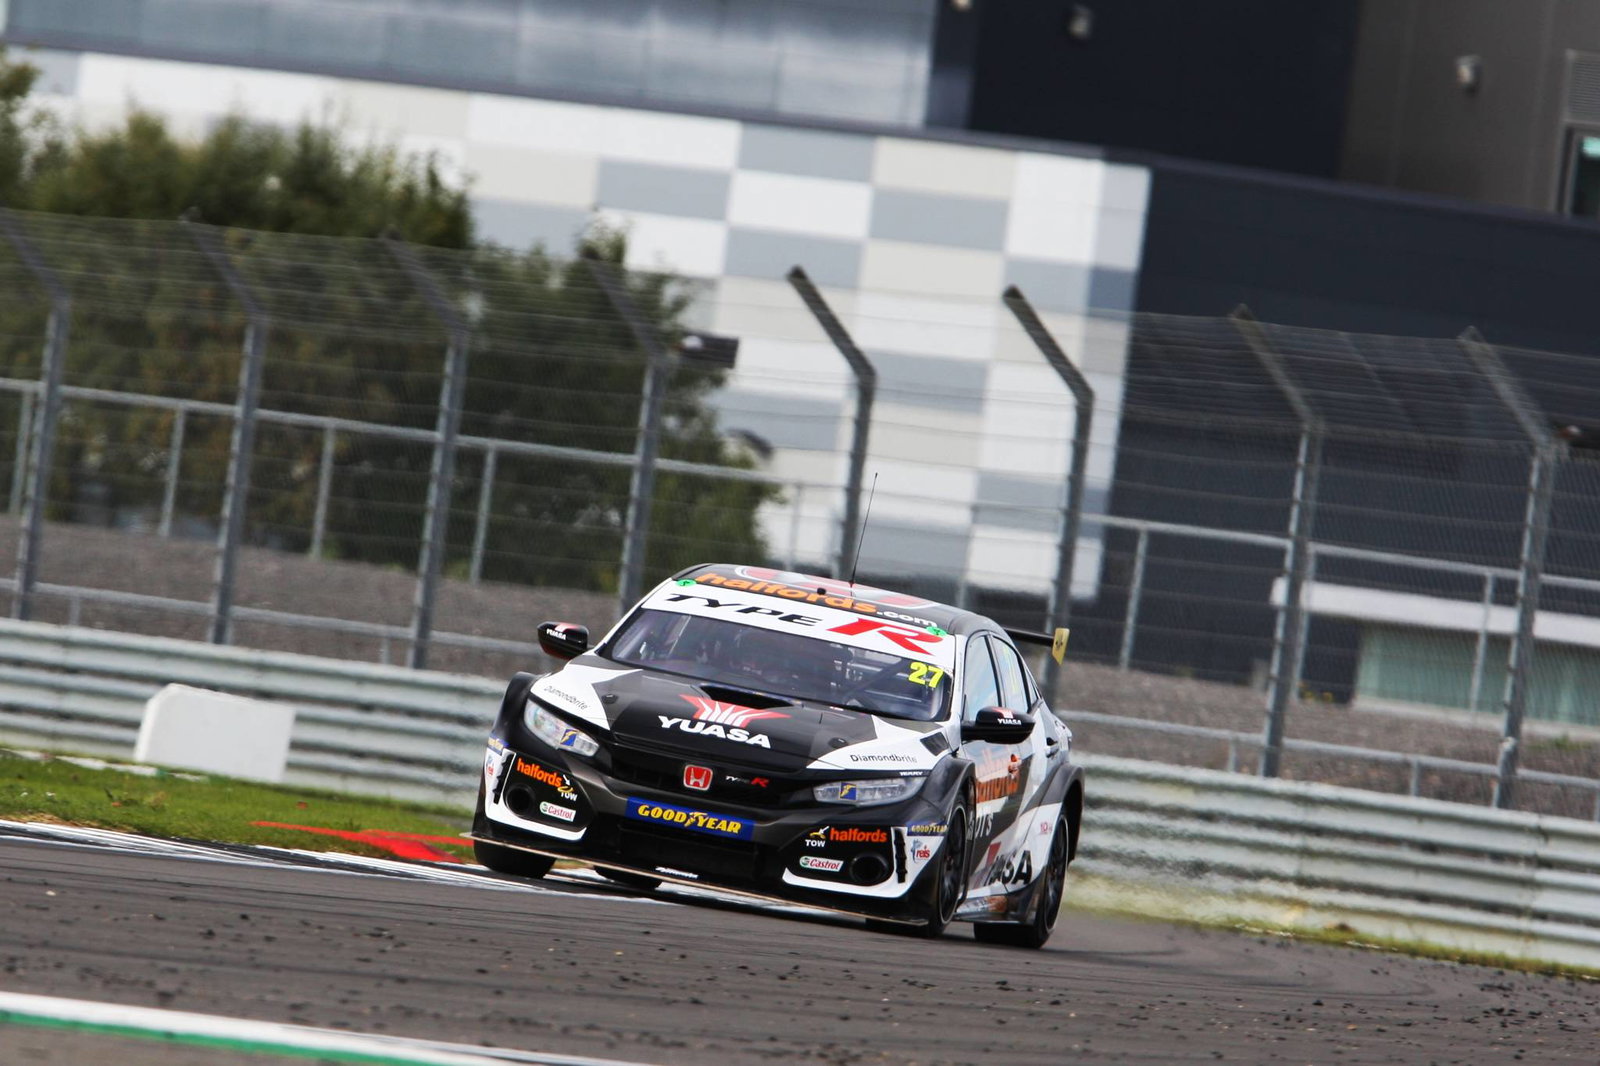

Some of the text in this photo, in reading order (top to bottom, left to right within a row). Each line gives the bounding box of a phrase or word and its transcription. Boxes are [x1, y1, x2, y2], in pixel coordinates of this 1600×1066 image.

[665, 593, 944, 656] TYPE R
[907, 661, 944, 689] 27
[997, 718, 1022, 726] YUASA
[658, 715, 771, 749] YUASA
[850, 754, 918, 764] Diamondbrite
[516, 758, 563, 788] halfords
[560, 790, 578, 802] TOW
[547, 805, 573, 819] Castrol
[829, 827, 888, 843] halfords
[804, 839, 827, 848] TOW
[808, 858, 841, 870] Castrol
